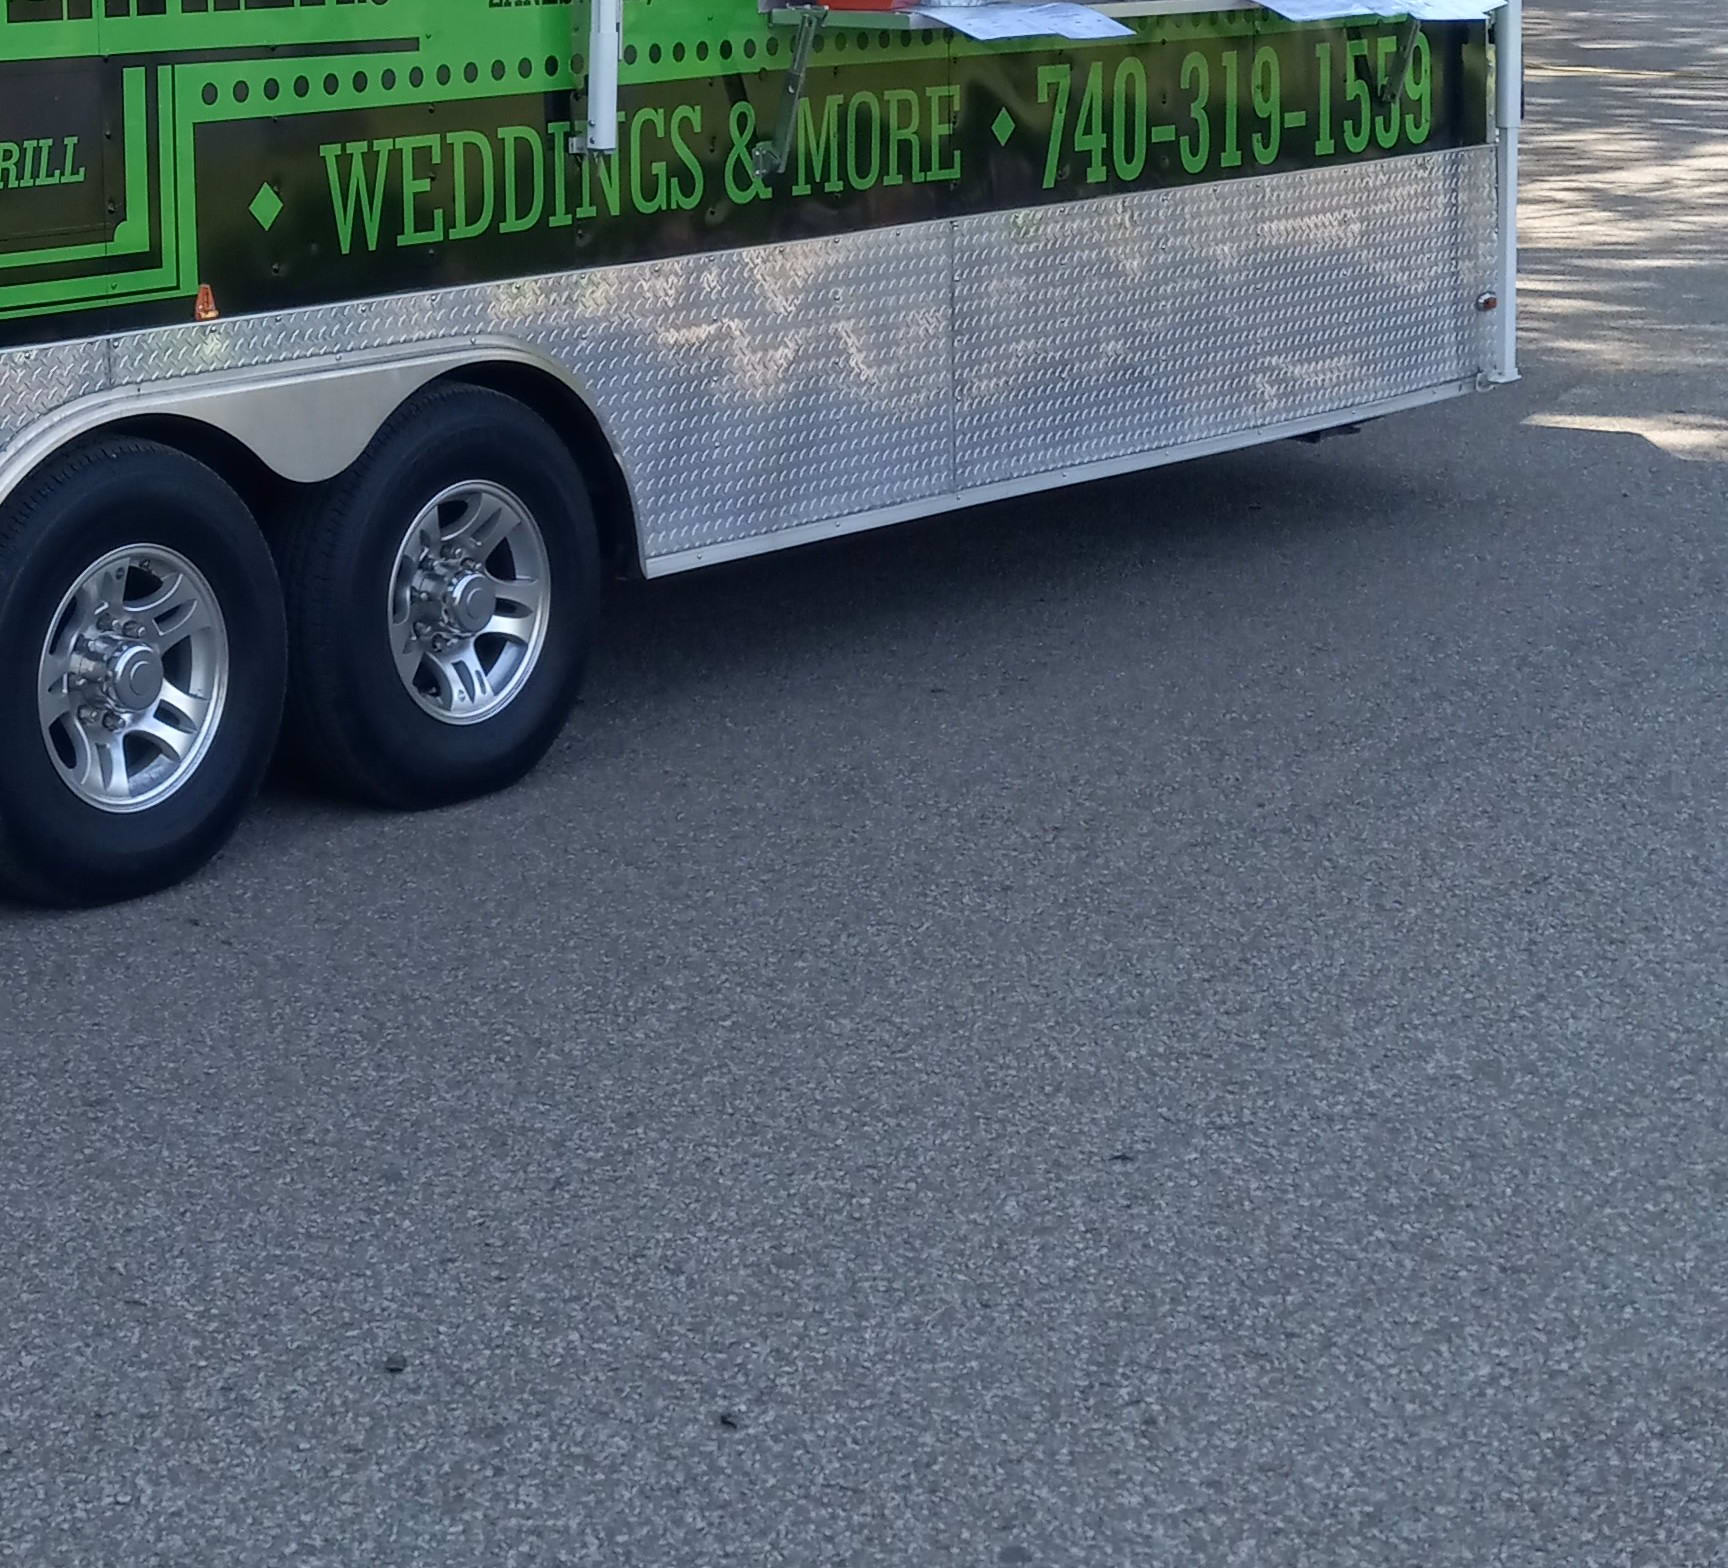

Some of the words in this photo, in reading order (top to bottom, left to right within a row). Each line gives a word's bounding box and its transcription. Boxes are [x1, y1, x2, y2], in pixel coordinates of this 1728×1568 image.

[319, 104, 704, 255] WEDDINGS
[725, 100, 773, 206] &
[791, 84, 962, 197] MORE
[1036, 31, 1432, 190] 740-319-1559
